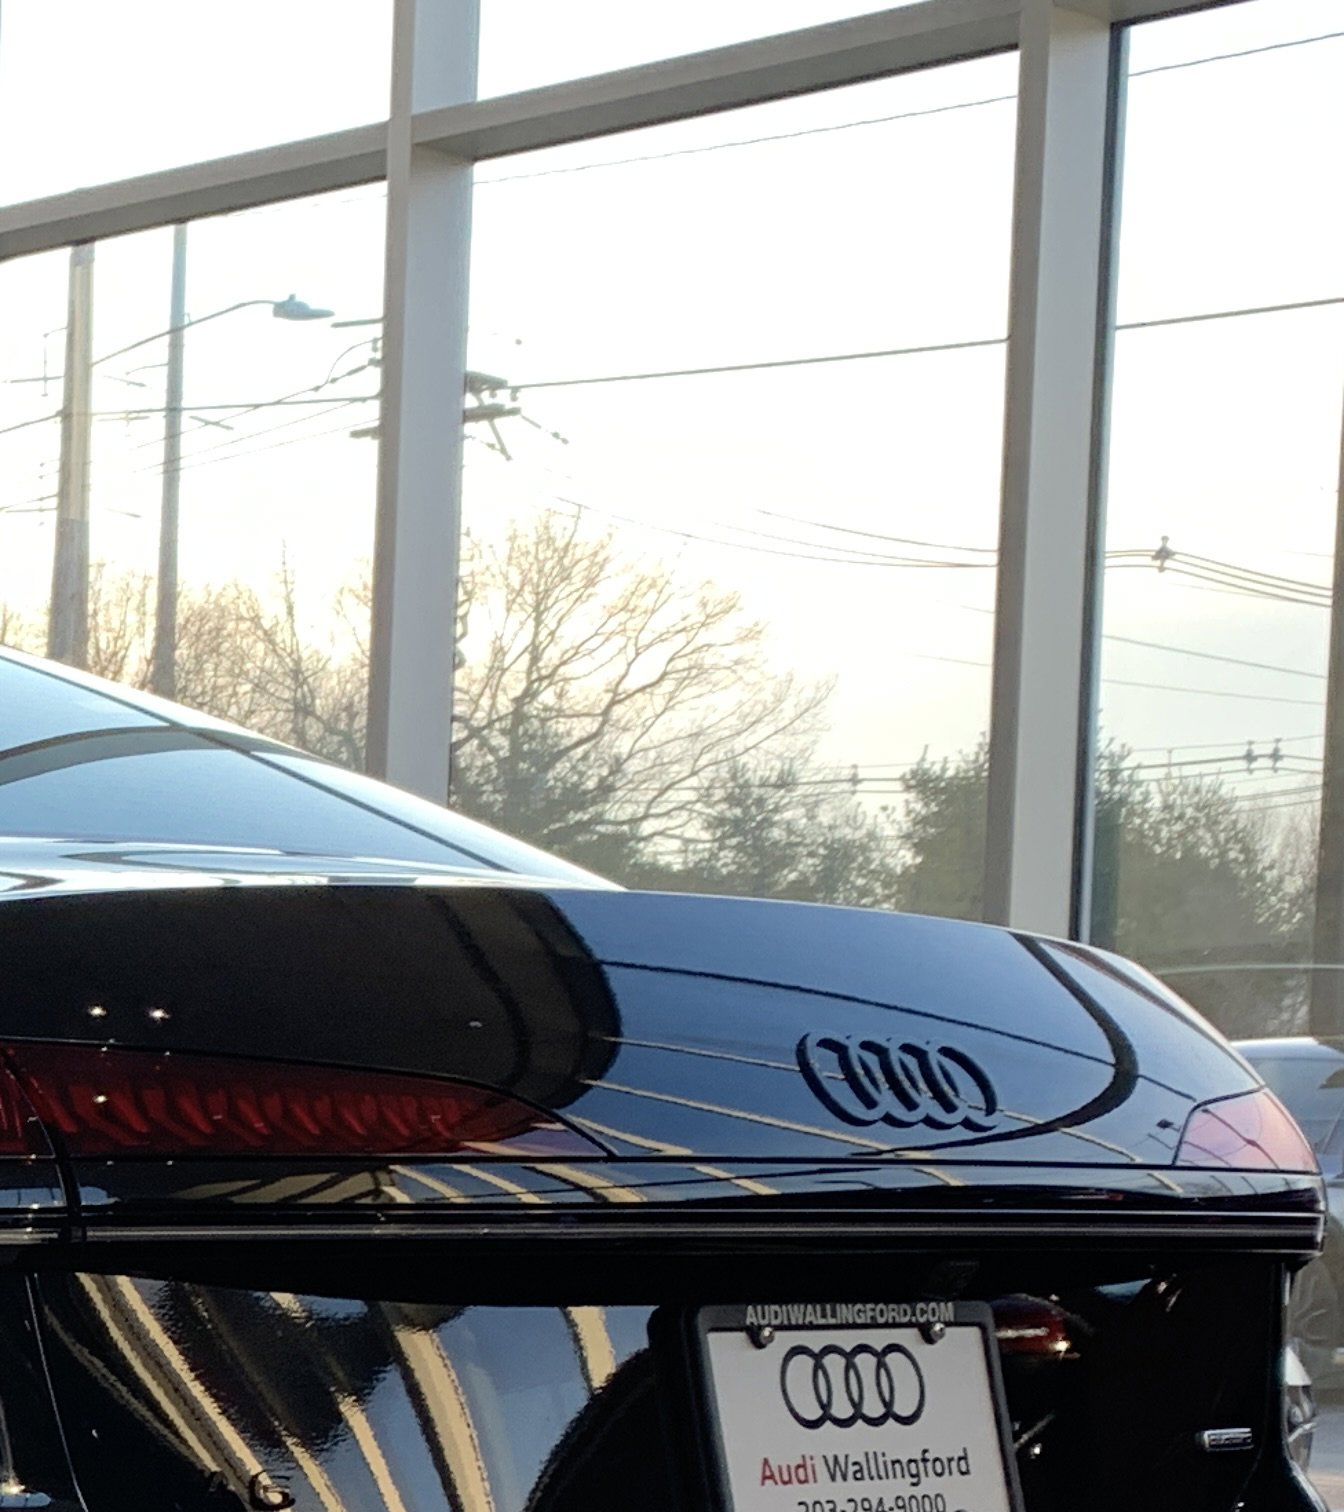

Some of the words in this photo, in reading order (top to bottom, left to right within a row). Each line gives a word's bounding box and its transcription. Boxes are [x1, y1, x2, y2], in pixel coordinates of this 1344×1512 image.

[745, 1302, 955, 1326] AUDIWALLINGFORD.COM
[760, 1455, 818, 1487] Audi
[823, 1448, 972, 1488] Wallingford
